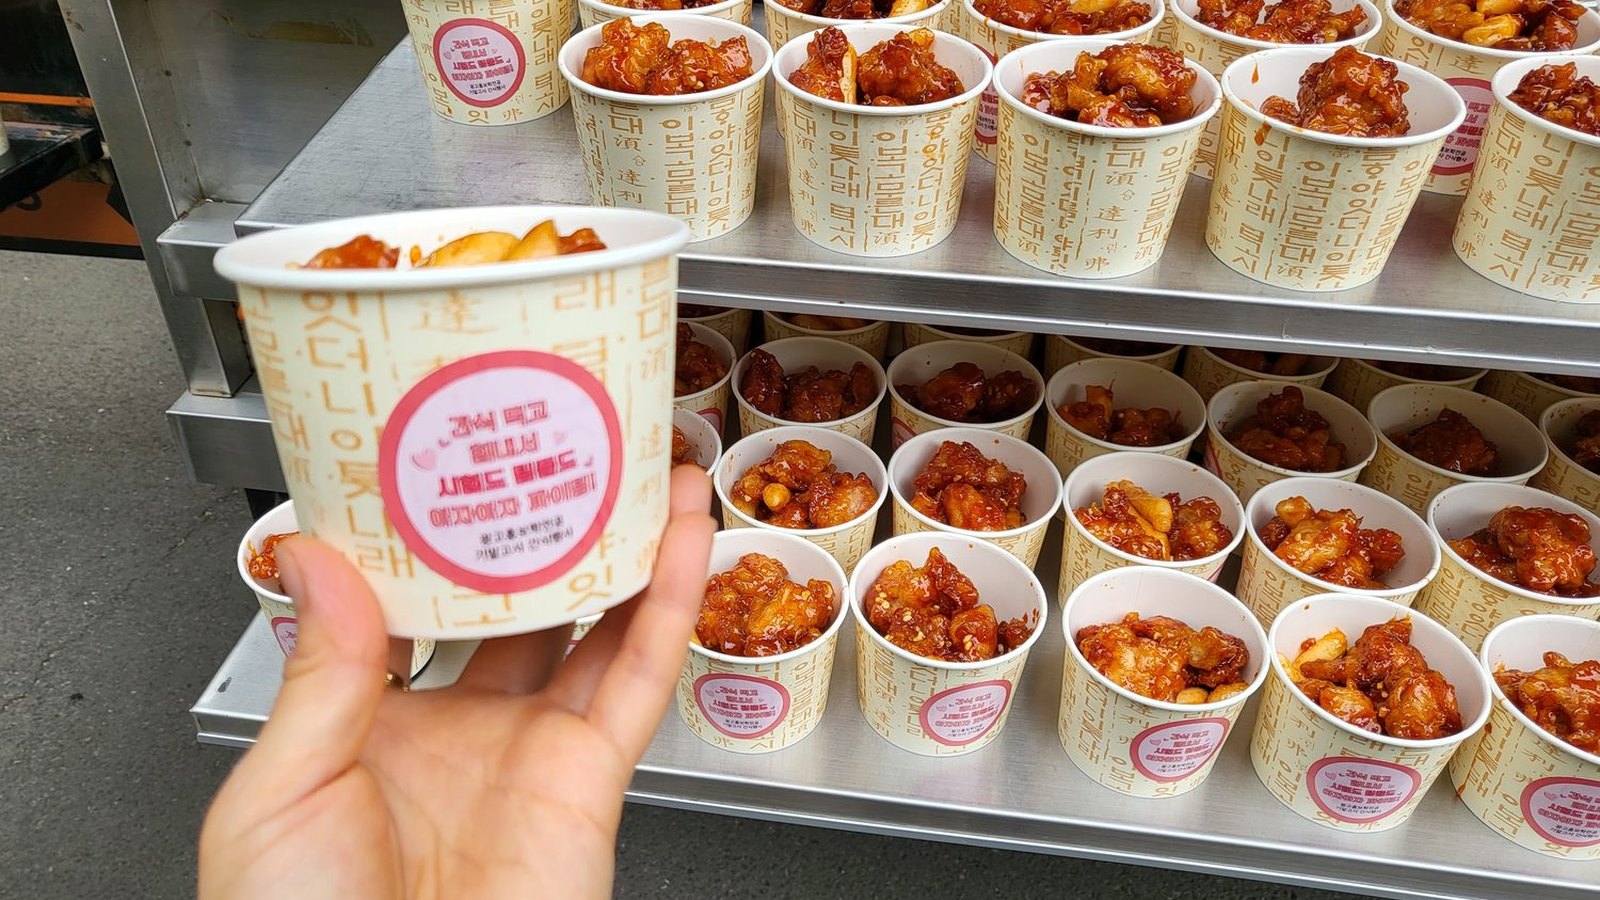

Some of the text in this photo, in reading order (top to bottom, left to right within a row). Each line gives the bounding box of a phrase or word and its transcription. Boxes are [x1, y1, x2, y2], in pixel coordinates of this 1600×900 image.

[449, 400, 549, 438] 간식 먹고
[439, 470, 506, 497] 시험도
